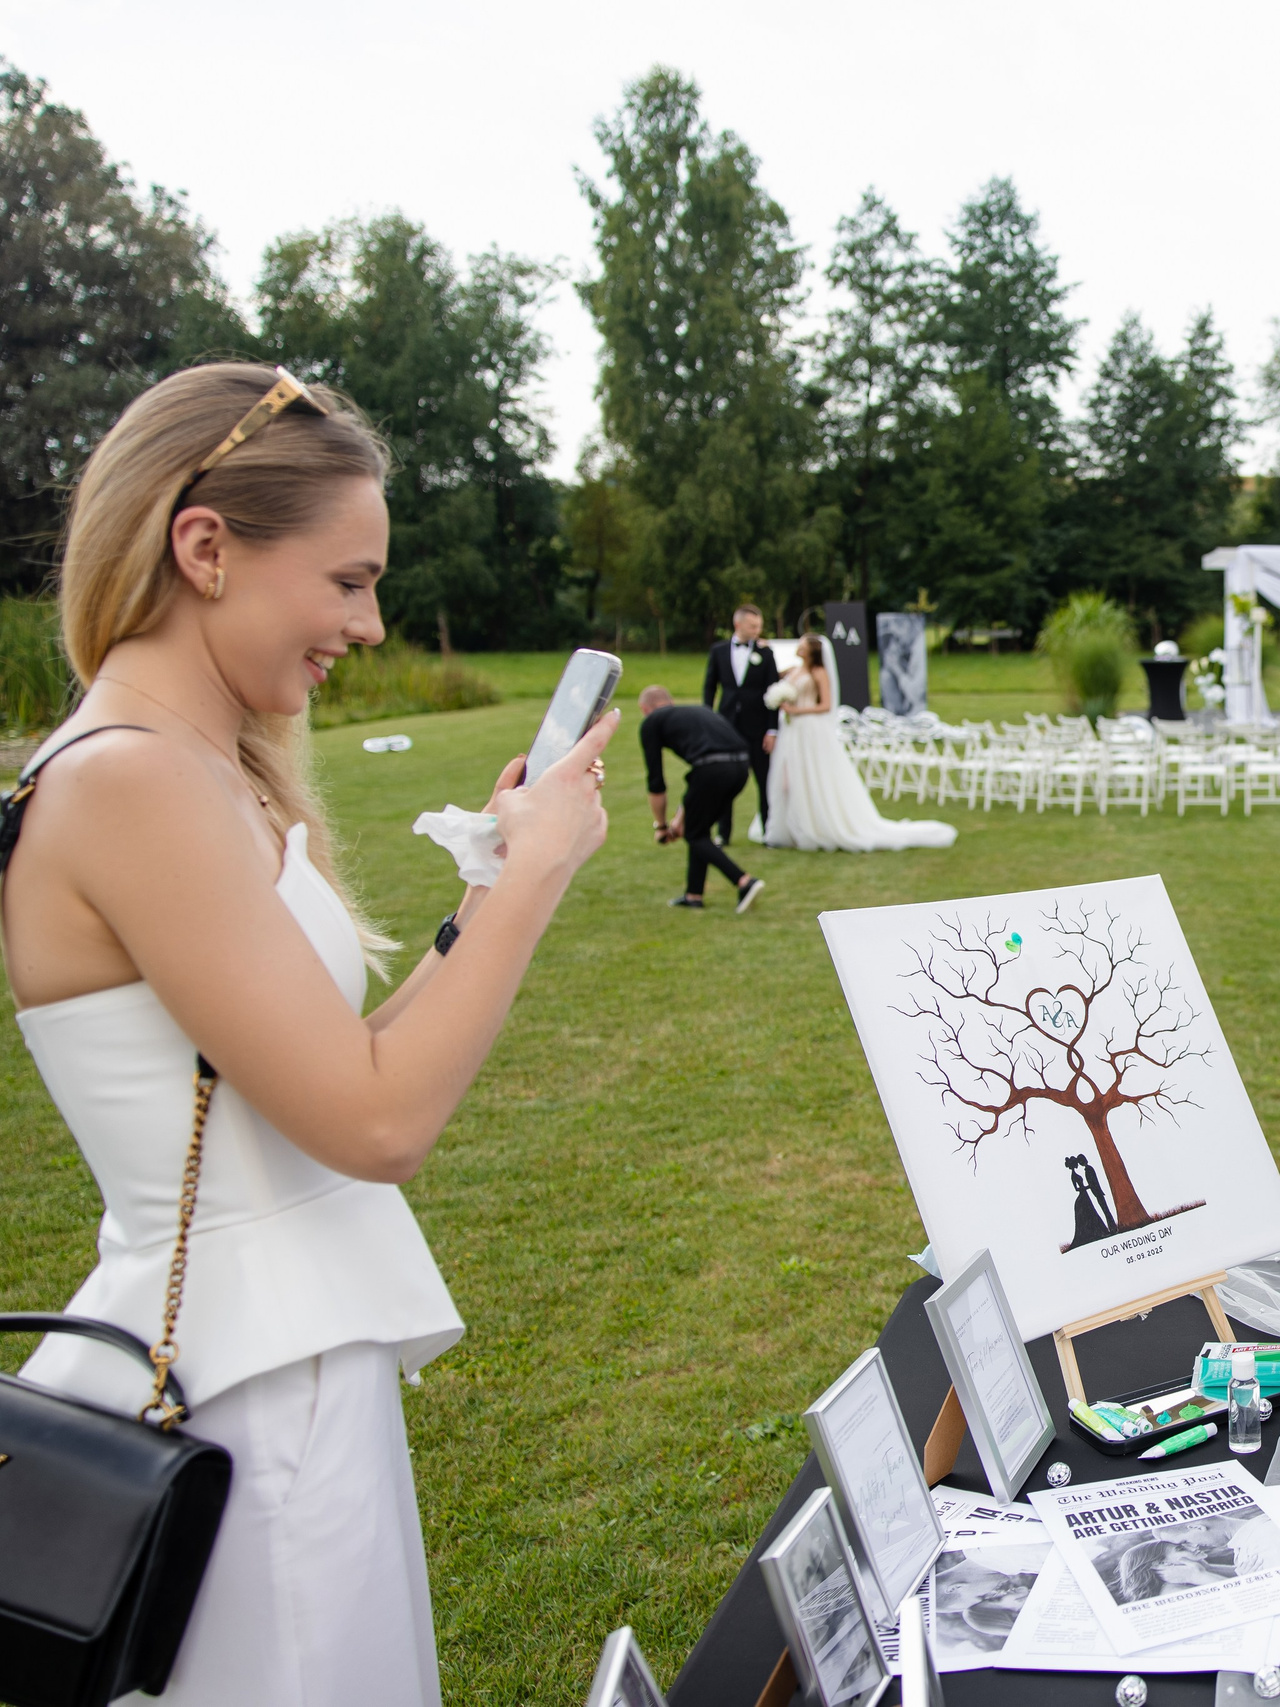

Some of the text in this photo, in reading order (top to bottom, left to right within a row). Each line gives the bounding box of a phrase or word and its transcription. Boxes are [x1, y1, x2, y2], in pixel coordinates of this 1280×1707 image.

[1101, 1226, 1173, 1258] OUR WEDDING DAY
[1126, 1245, 1163, 1264] 05.09.2025
[1058, 1494, 1092, 1505] The
[1096, 1482, 1179, 1499] Wedding
[1182, 1472, 1226, 1488] Post
[1115, 1476, 1159, 1487] BREAKING NEWS
[1065, 1504, 1140, 1528] ARTUR
[1145, 1502, 1162, 1515] &
[1164, 1485, 1246, 1510] NASTIA
[1072, 1495, 1255, 1540] ARE GETTING MARRIED
[1122, 1604, 1152, 1615] THE
[1154, 1585, 1221, 1607] WEDDING
[1223, 1580, 1241, 1590] OF
[1245, 1571, 1274, 1584] THE
